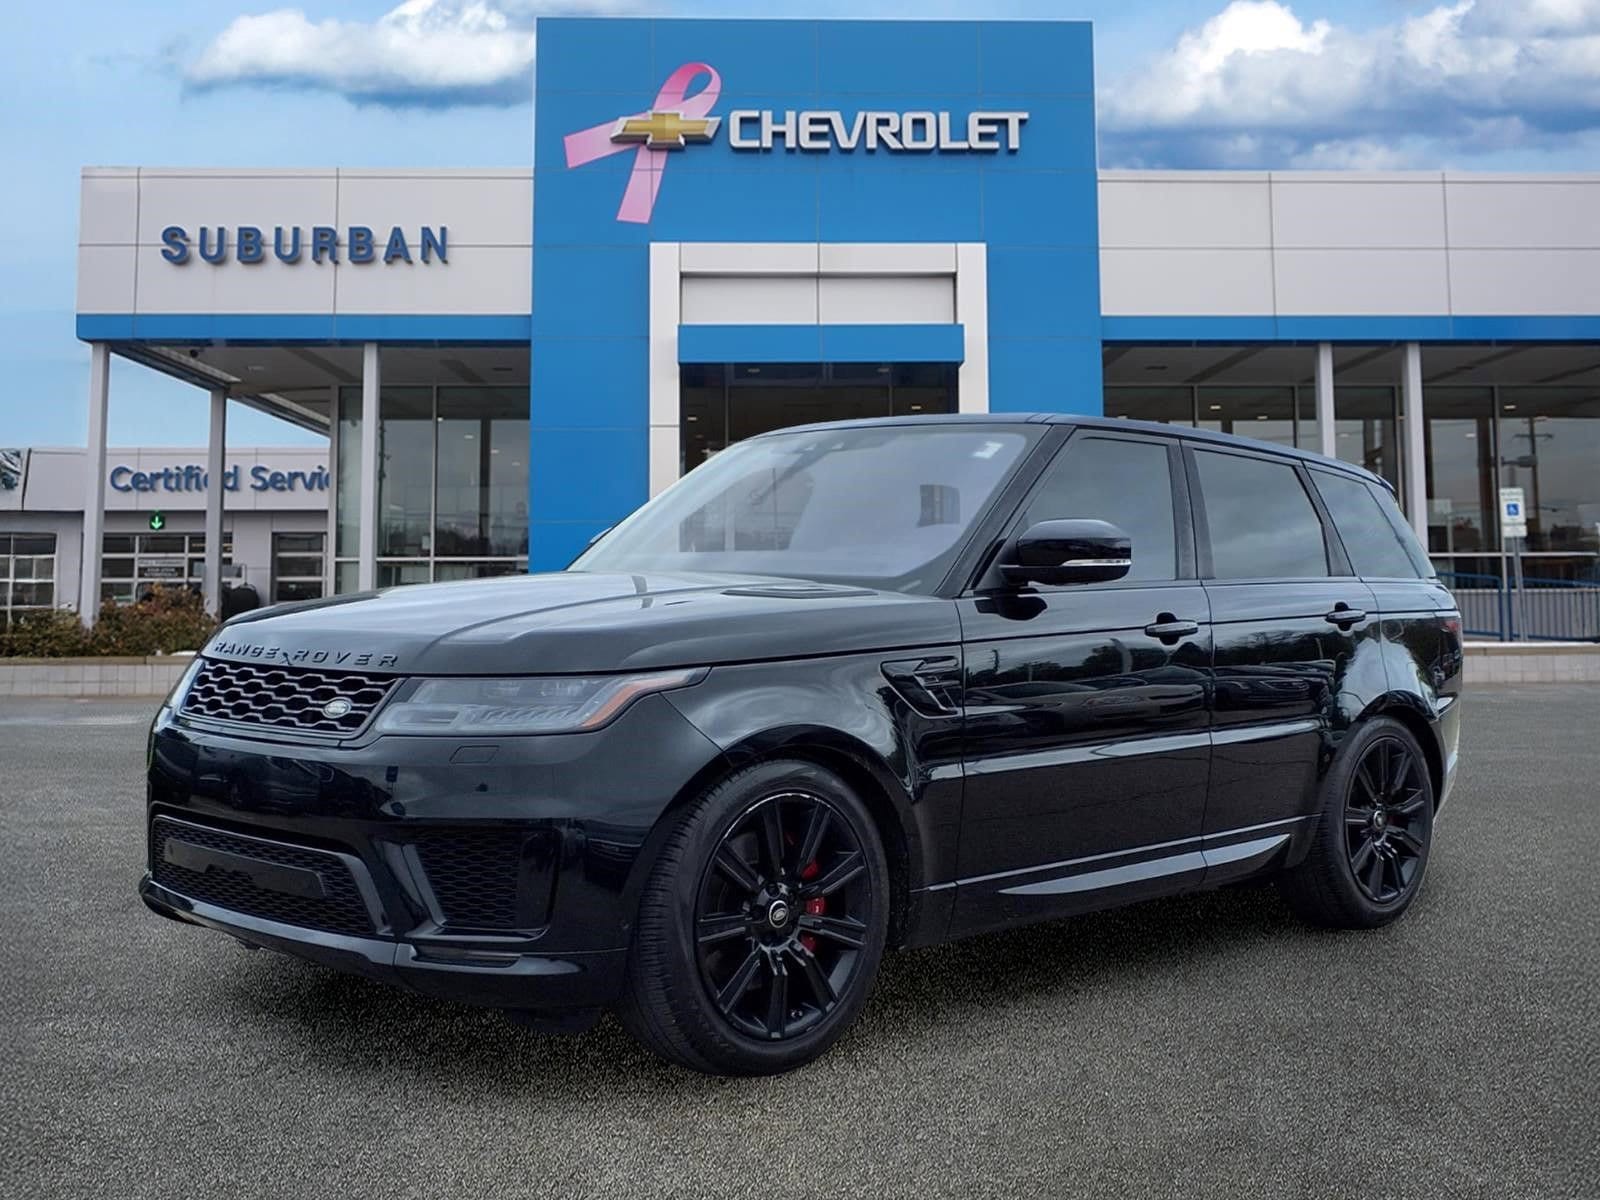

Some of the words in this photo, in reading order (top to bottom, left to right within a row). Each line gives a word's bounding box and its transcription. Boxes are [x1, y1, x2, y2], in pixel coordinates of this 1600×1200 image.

[728, 109, 1029, 150] CHEVROLET
[161, 226, 449, 265] SUBURBAN
[110, 465, 240, 492] Certifid
[214, 642, 280, 660] RANGE
[293, 650, 398, 667] ROVER
